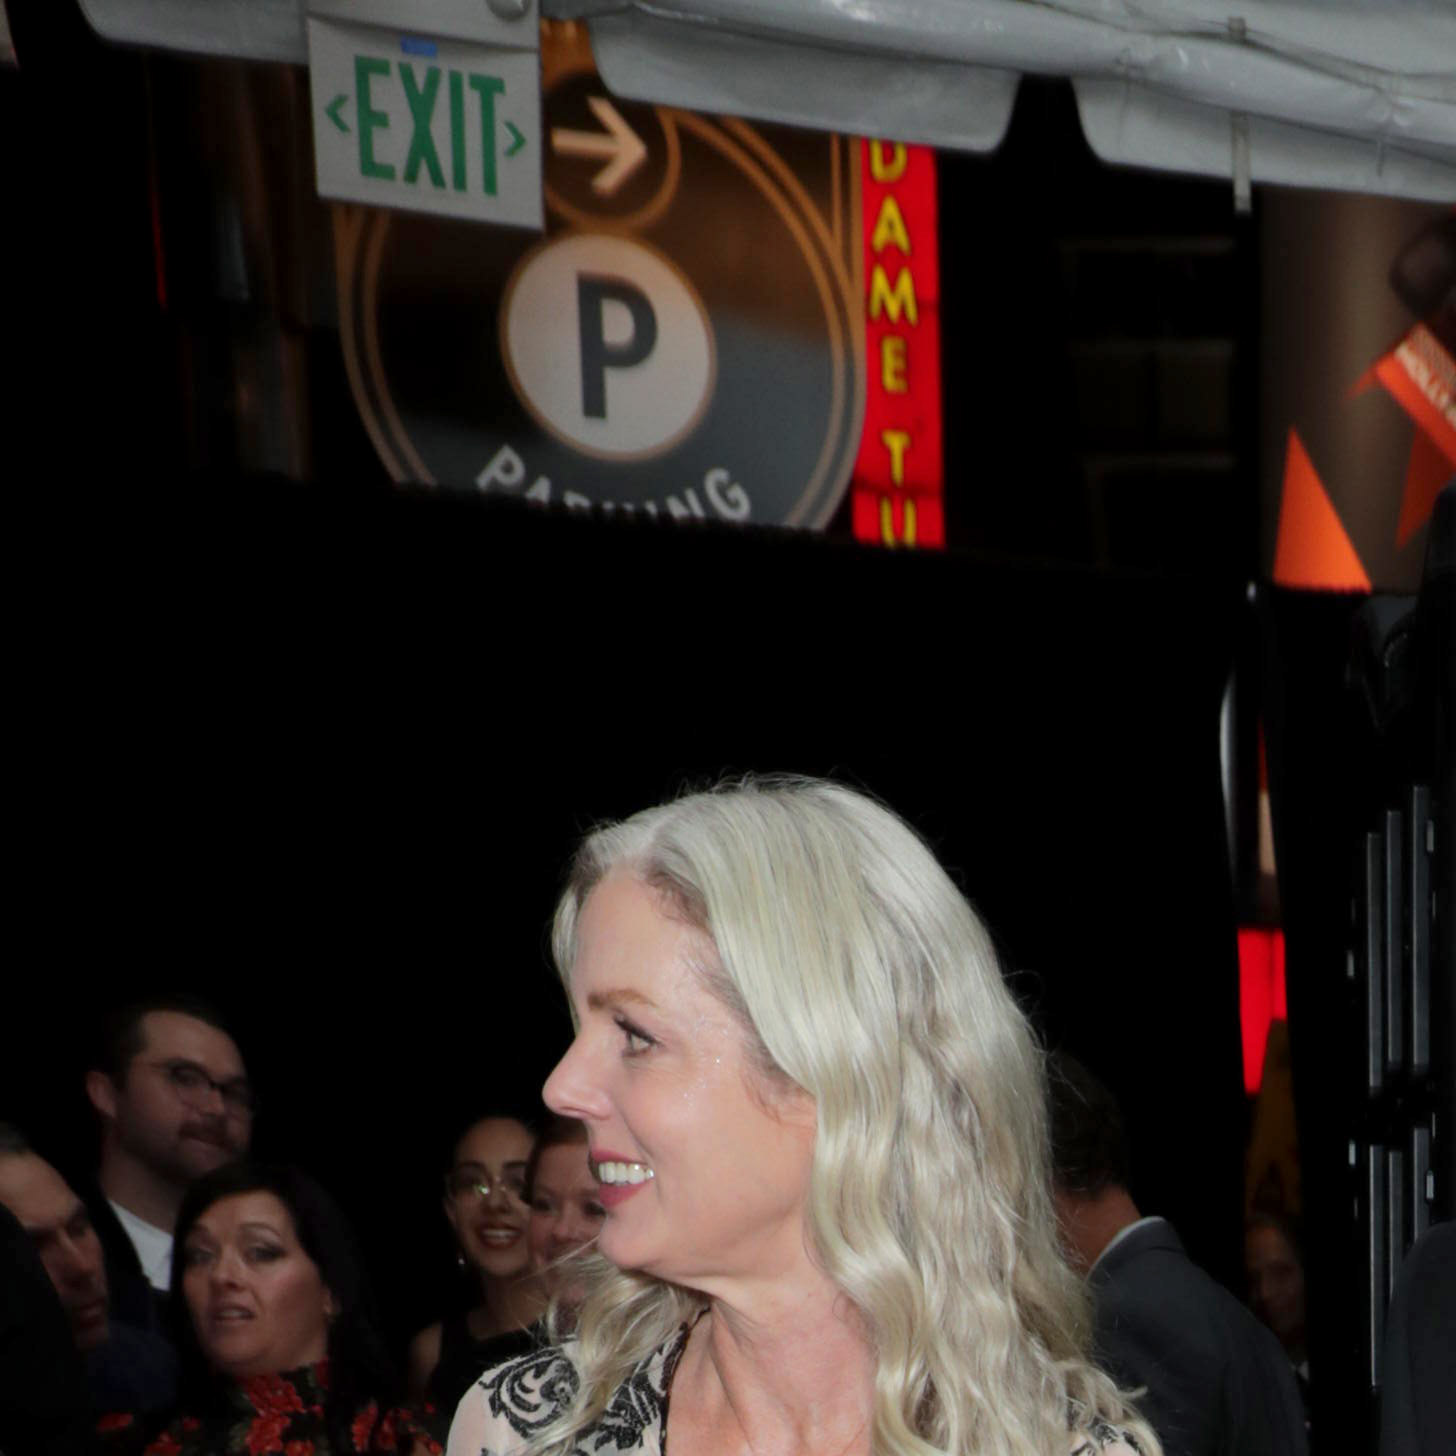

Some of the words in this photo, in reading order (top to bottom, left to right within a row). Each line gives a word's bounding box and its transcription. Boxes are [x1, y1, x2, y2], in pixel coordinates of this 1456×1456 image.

[354, 55, 506, 197] EXIT
[576, 271, 659, 420] P
[475, 444, 751, 522] PANG
